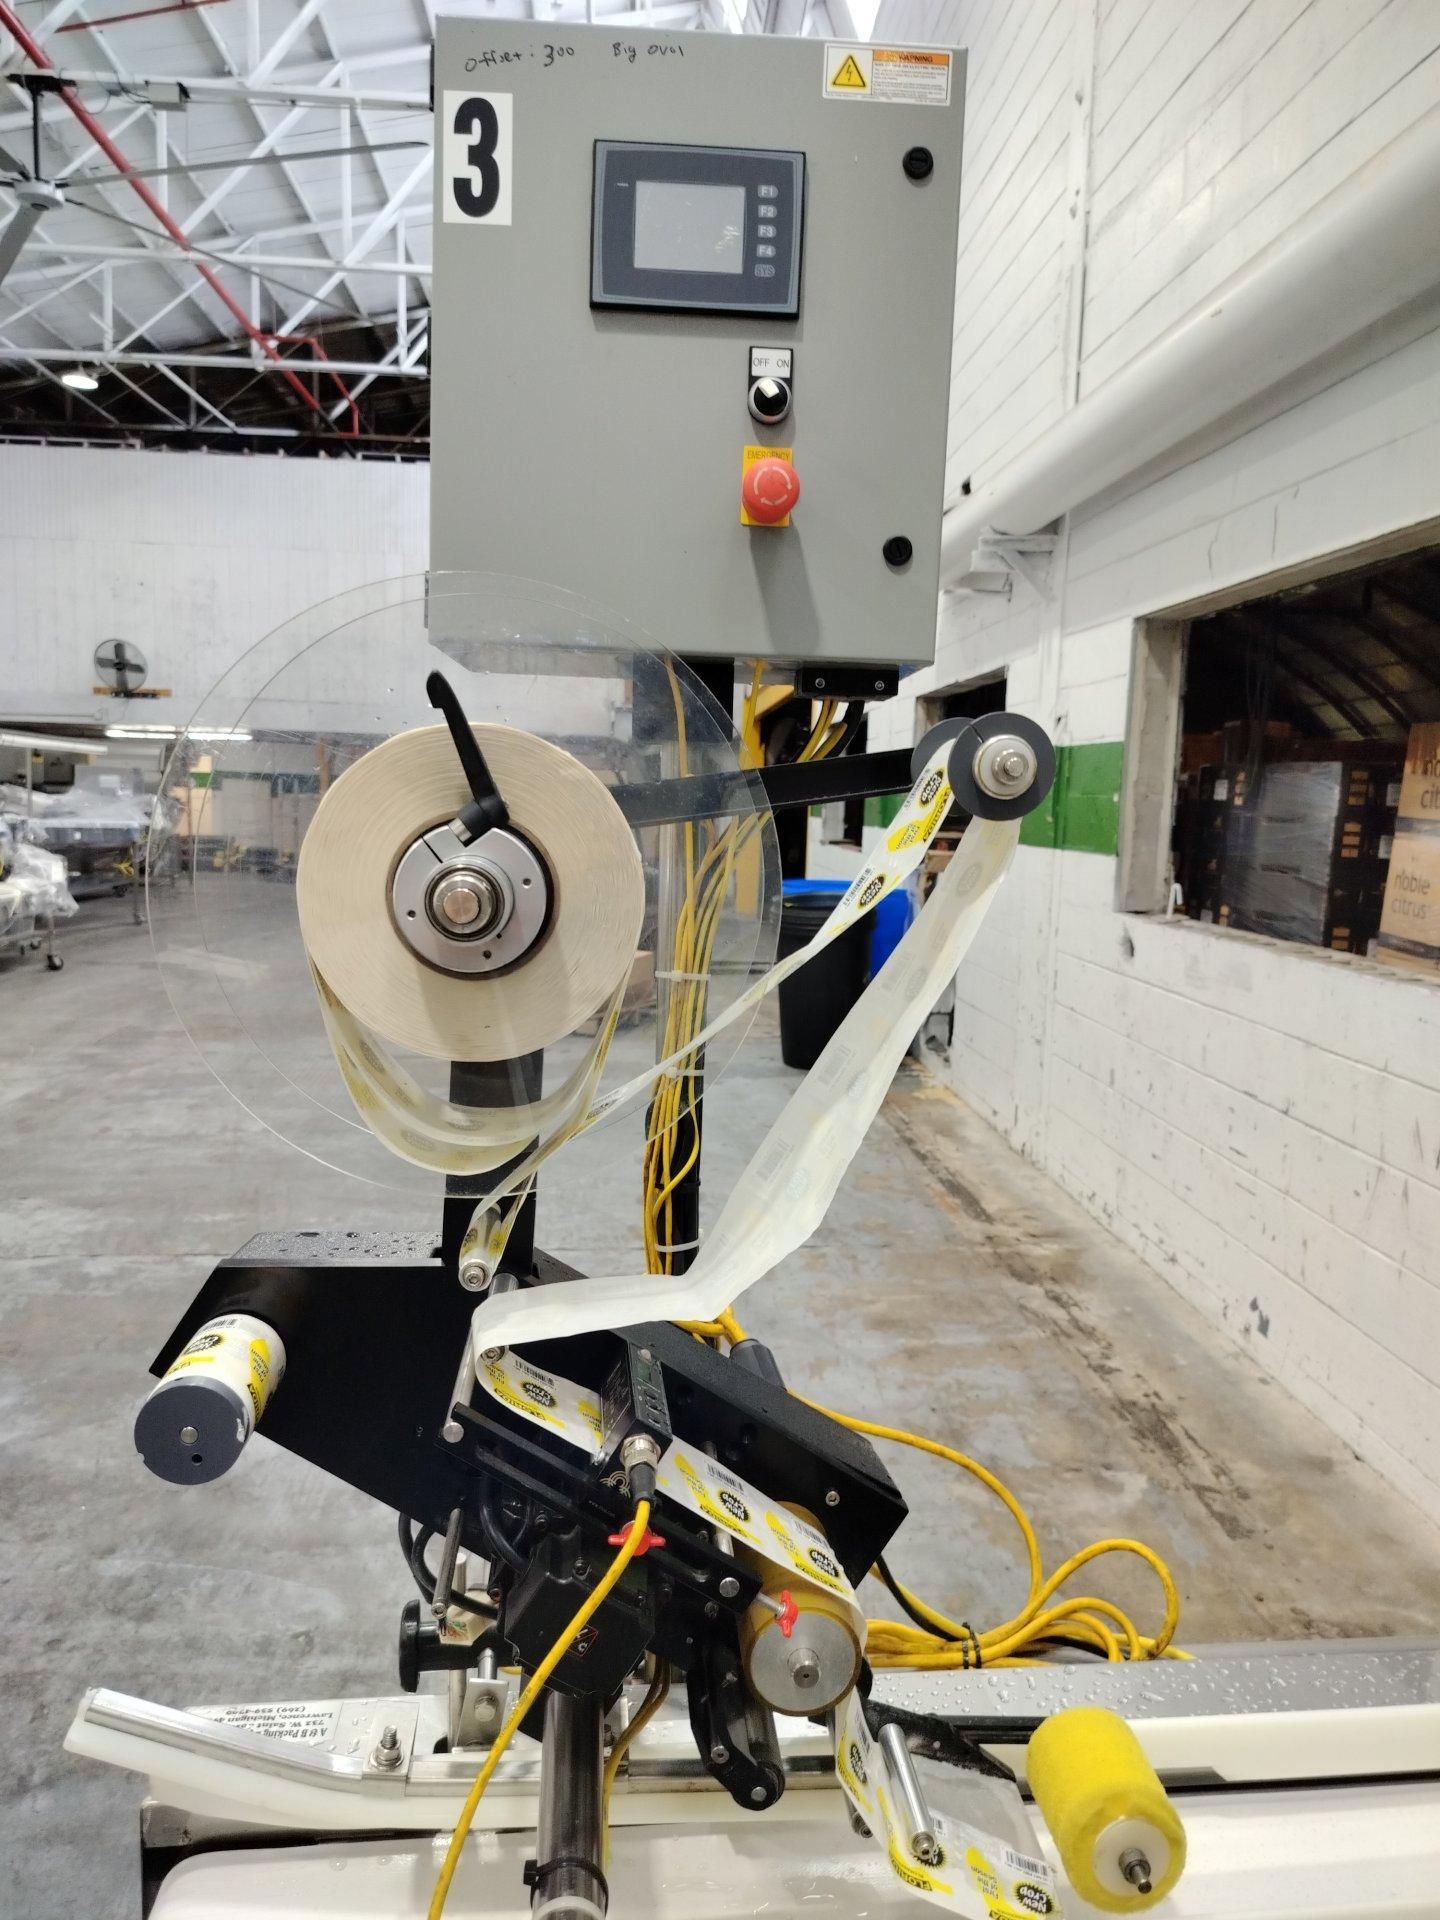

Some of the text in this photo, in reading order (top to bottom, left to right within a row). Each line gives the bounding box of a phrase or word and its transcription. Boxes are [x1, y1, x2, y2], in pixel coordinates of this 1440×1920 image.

[543, 44, 575, 67] 300
[612, 42, 637, 64] Big
[453, 97, 500, 218] 3
[761, 186, 773, 196] F1
[760, 206, 774, 217] F2
[760, 226, 773, 238] F3
[759, 246, 773, 256] F4
[752, 358, 790, 368] OFF ON
[747, 449, 790, 460] EMERGENCY
[1394, 869, 1431, 896] noble
[1391, 899, 1427, 920] citrus
[228, 1715, 276, 1723] Michigan
[263, 1730, 299, 1739] Packing
[300, 1728, 309, 1738] B
[320, 1727, 328, 1737] A
[1019, 1886, 1047, 1904] Crop
[1023, 1897, 1047, 1913] New
